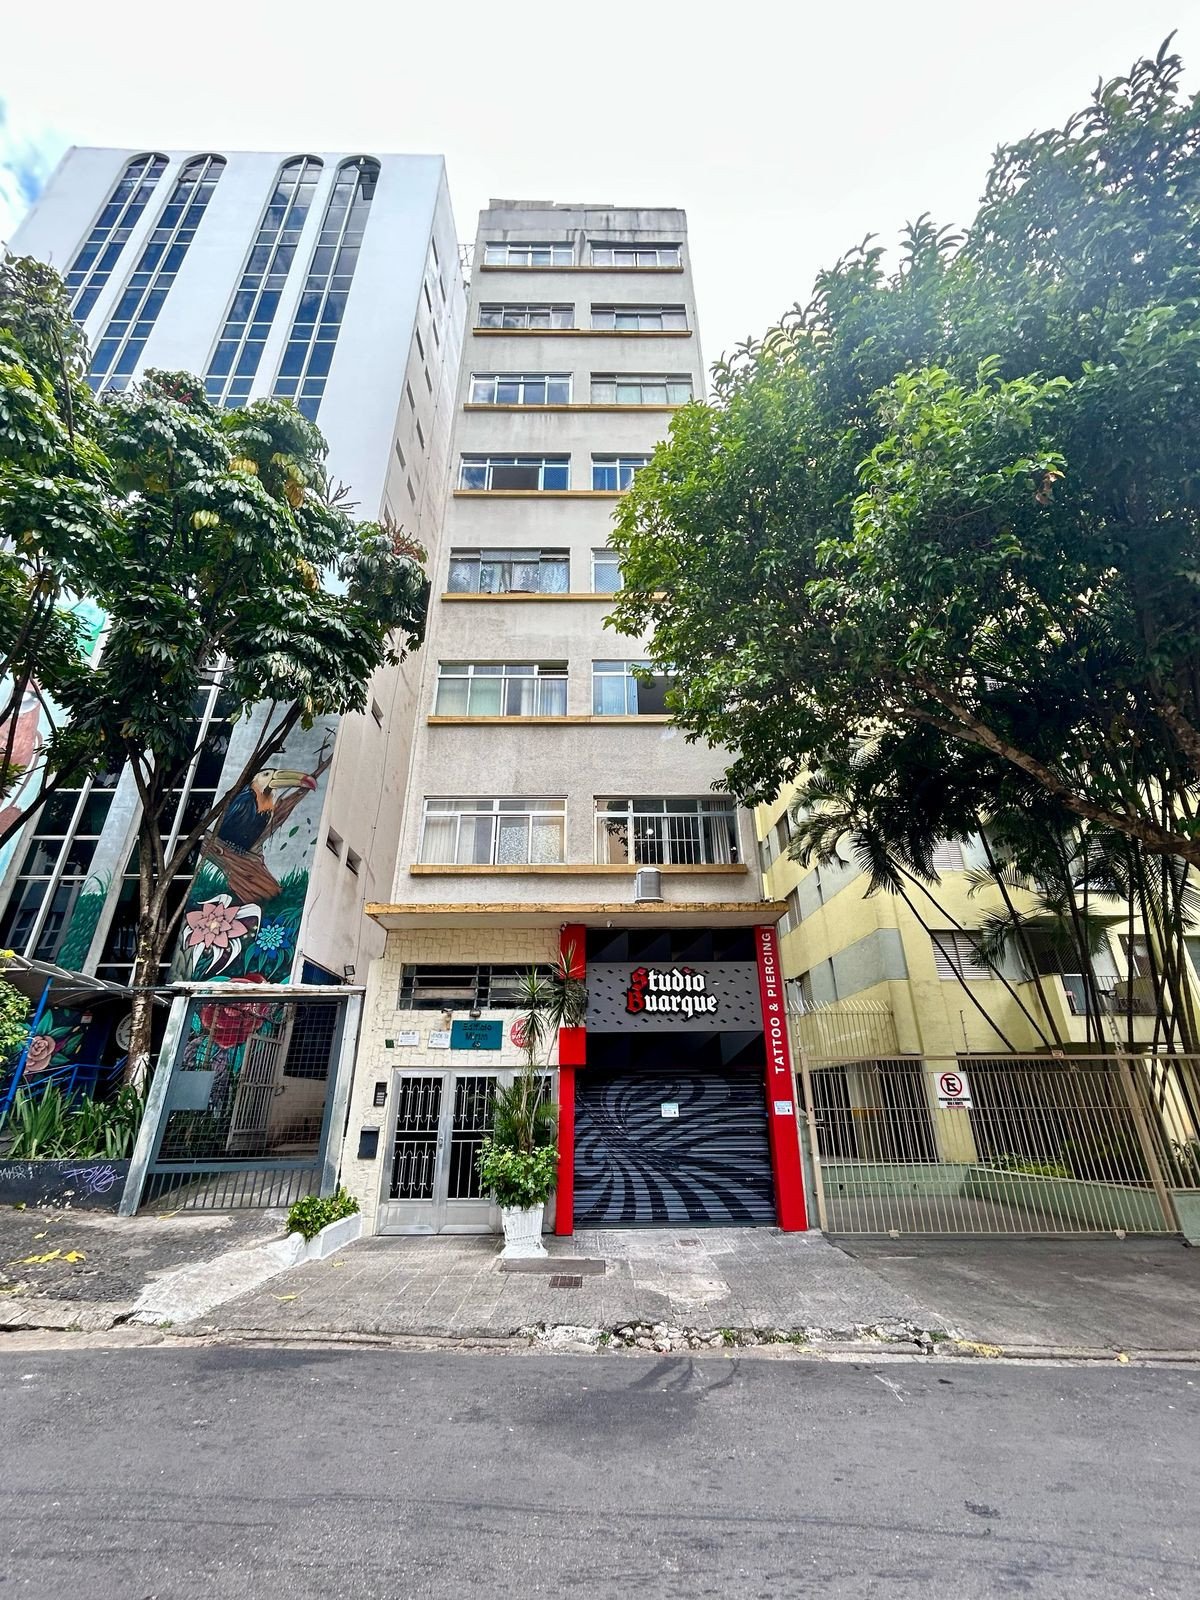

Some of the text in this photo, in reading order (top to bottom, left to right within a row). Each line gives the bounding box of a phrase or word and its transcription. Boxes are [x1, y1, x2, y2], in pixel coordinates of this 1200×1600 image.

[631, 967, 706, 992] Studio
[626, 989, 718, 1018] Buarque
[761, 932, 786, 1075] TATTOO & PIERCING
